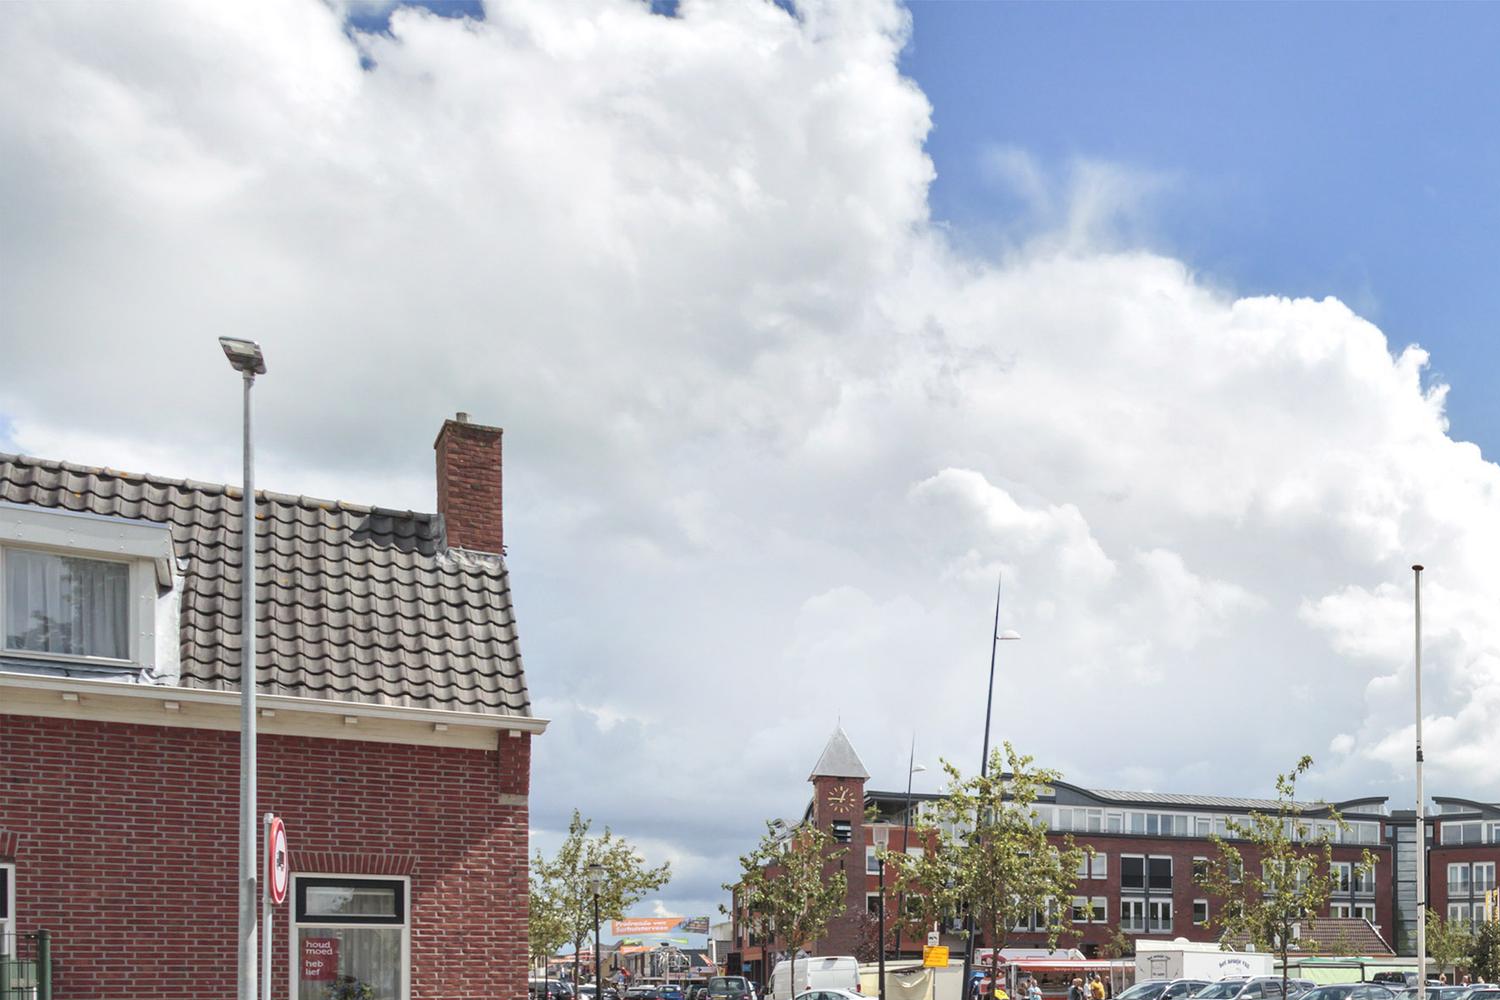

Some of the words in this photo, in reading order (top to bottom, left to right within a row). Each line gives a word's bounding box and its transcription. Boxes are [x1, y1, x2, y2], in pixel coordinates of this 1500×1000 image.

[305, 940, 331, 948] houd
[305, 959, 324, 968] heb
[305, 968, 321, 976] lief
